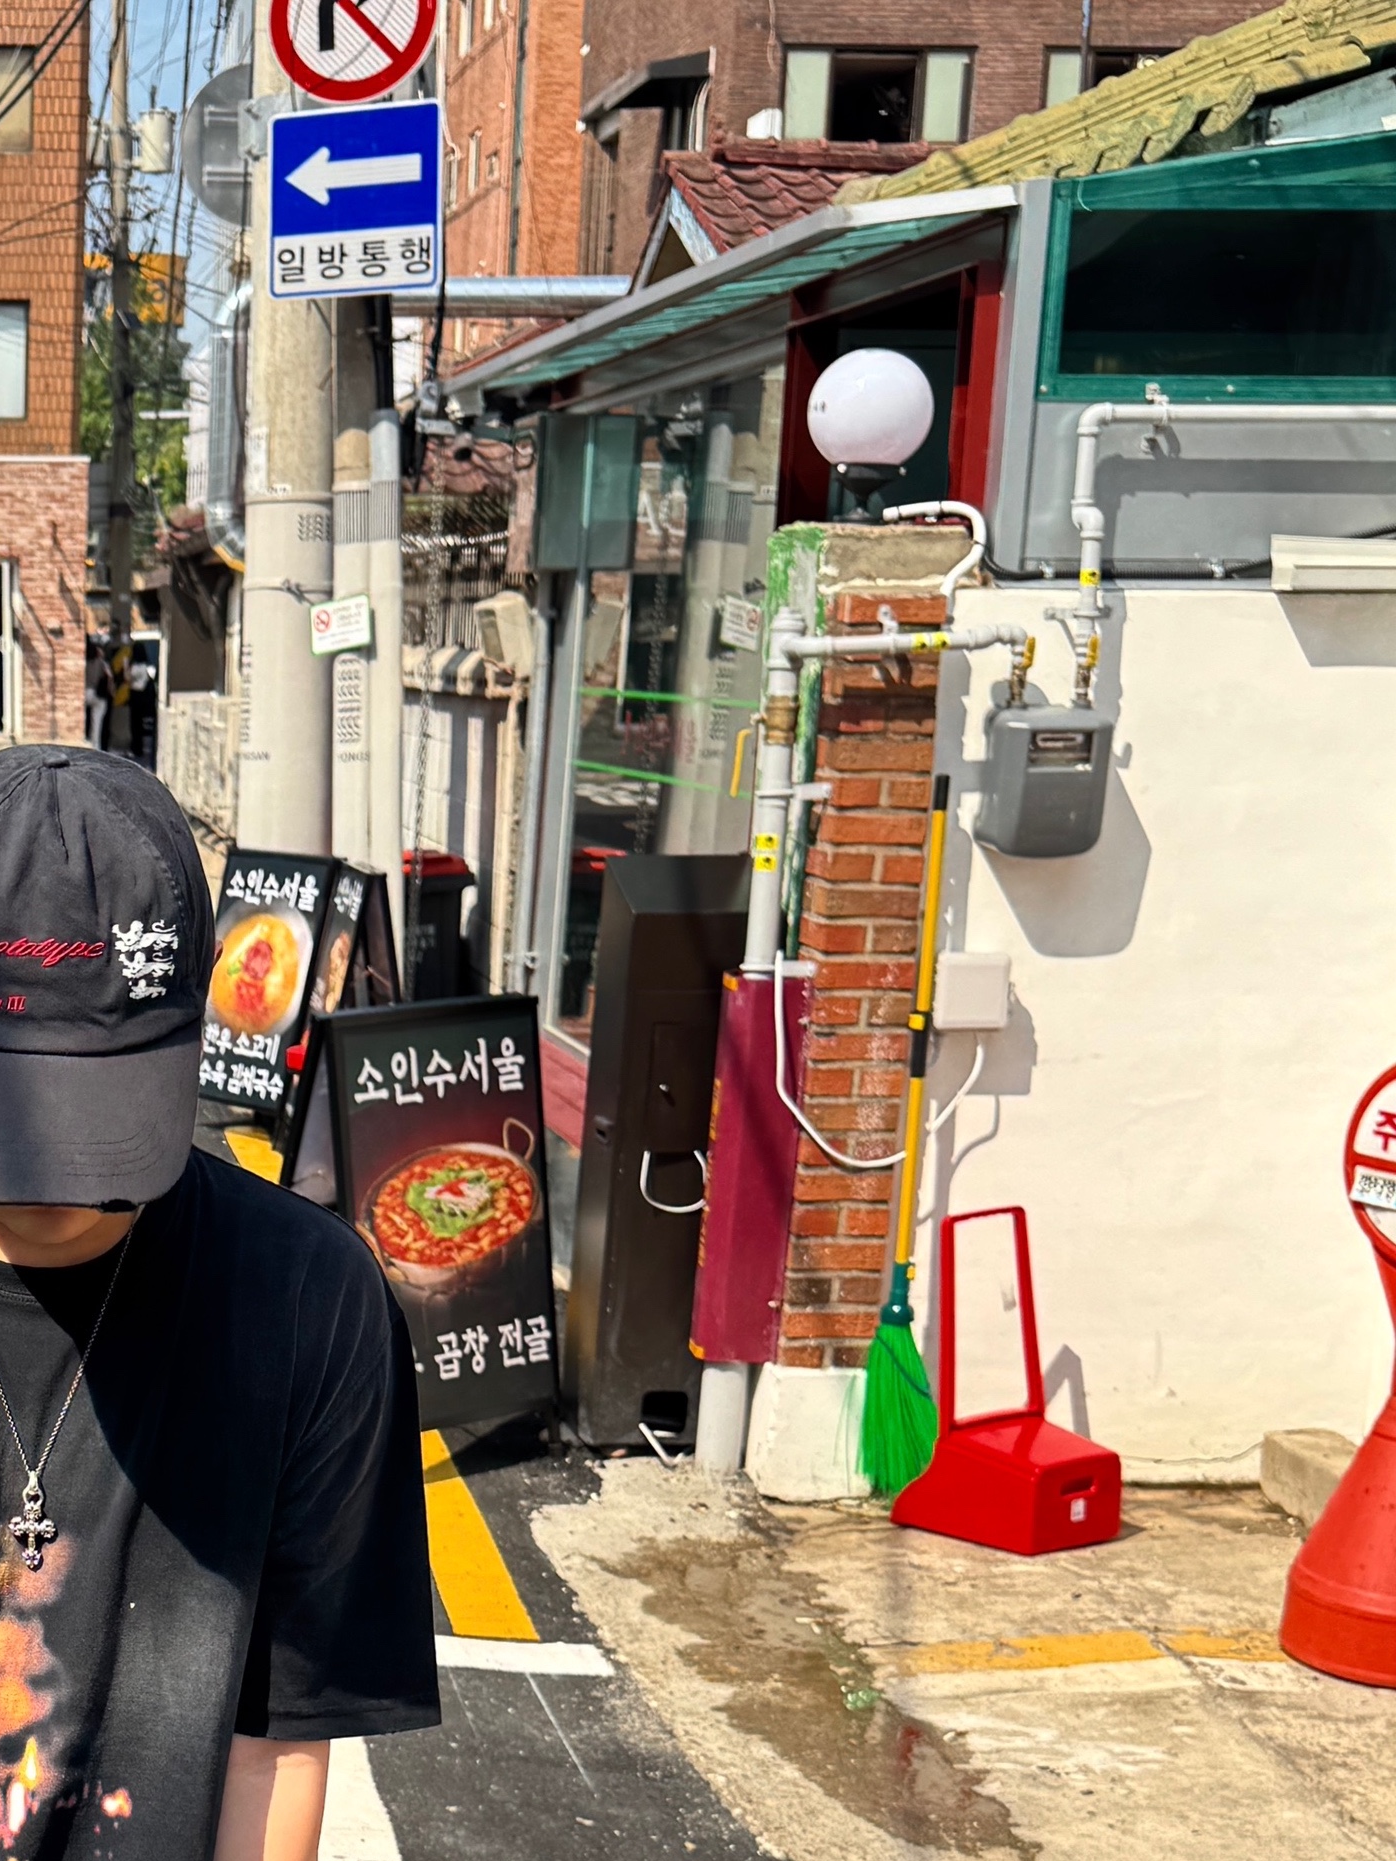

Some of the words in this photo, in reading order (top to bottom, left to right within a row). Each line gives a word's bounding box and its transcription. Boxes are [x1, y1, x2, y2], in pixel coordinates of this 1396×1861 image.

[277, 235, 431, 284] 일방통행
[226, 868, 319, 913] 소인수서울
[232, 1031, 281, 1066] 소고기
[354, 1036, 526, 1106] 소인수서울
[434, 1324, 490, 1381] 곱창
[497, 1314, 552, 1368] 전골
